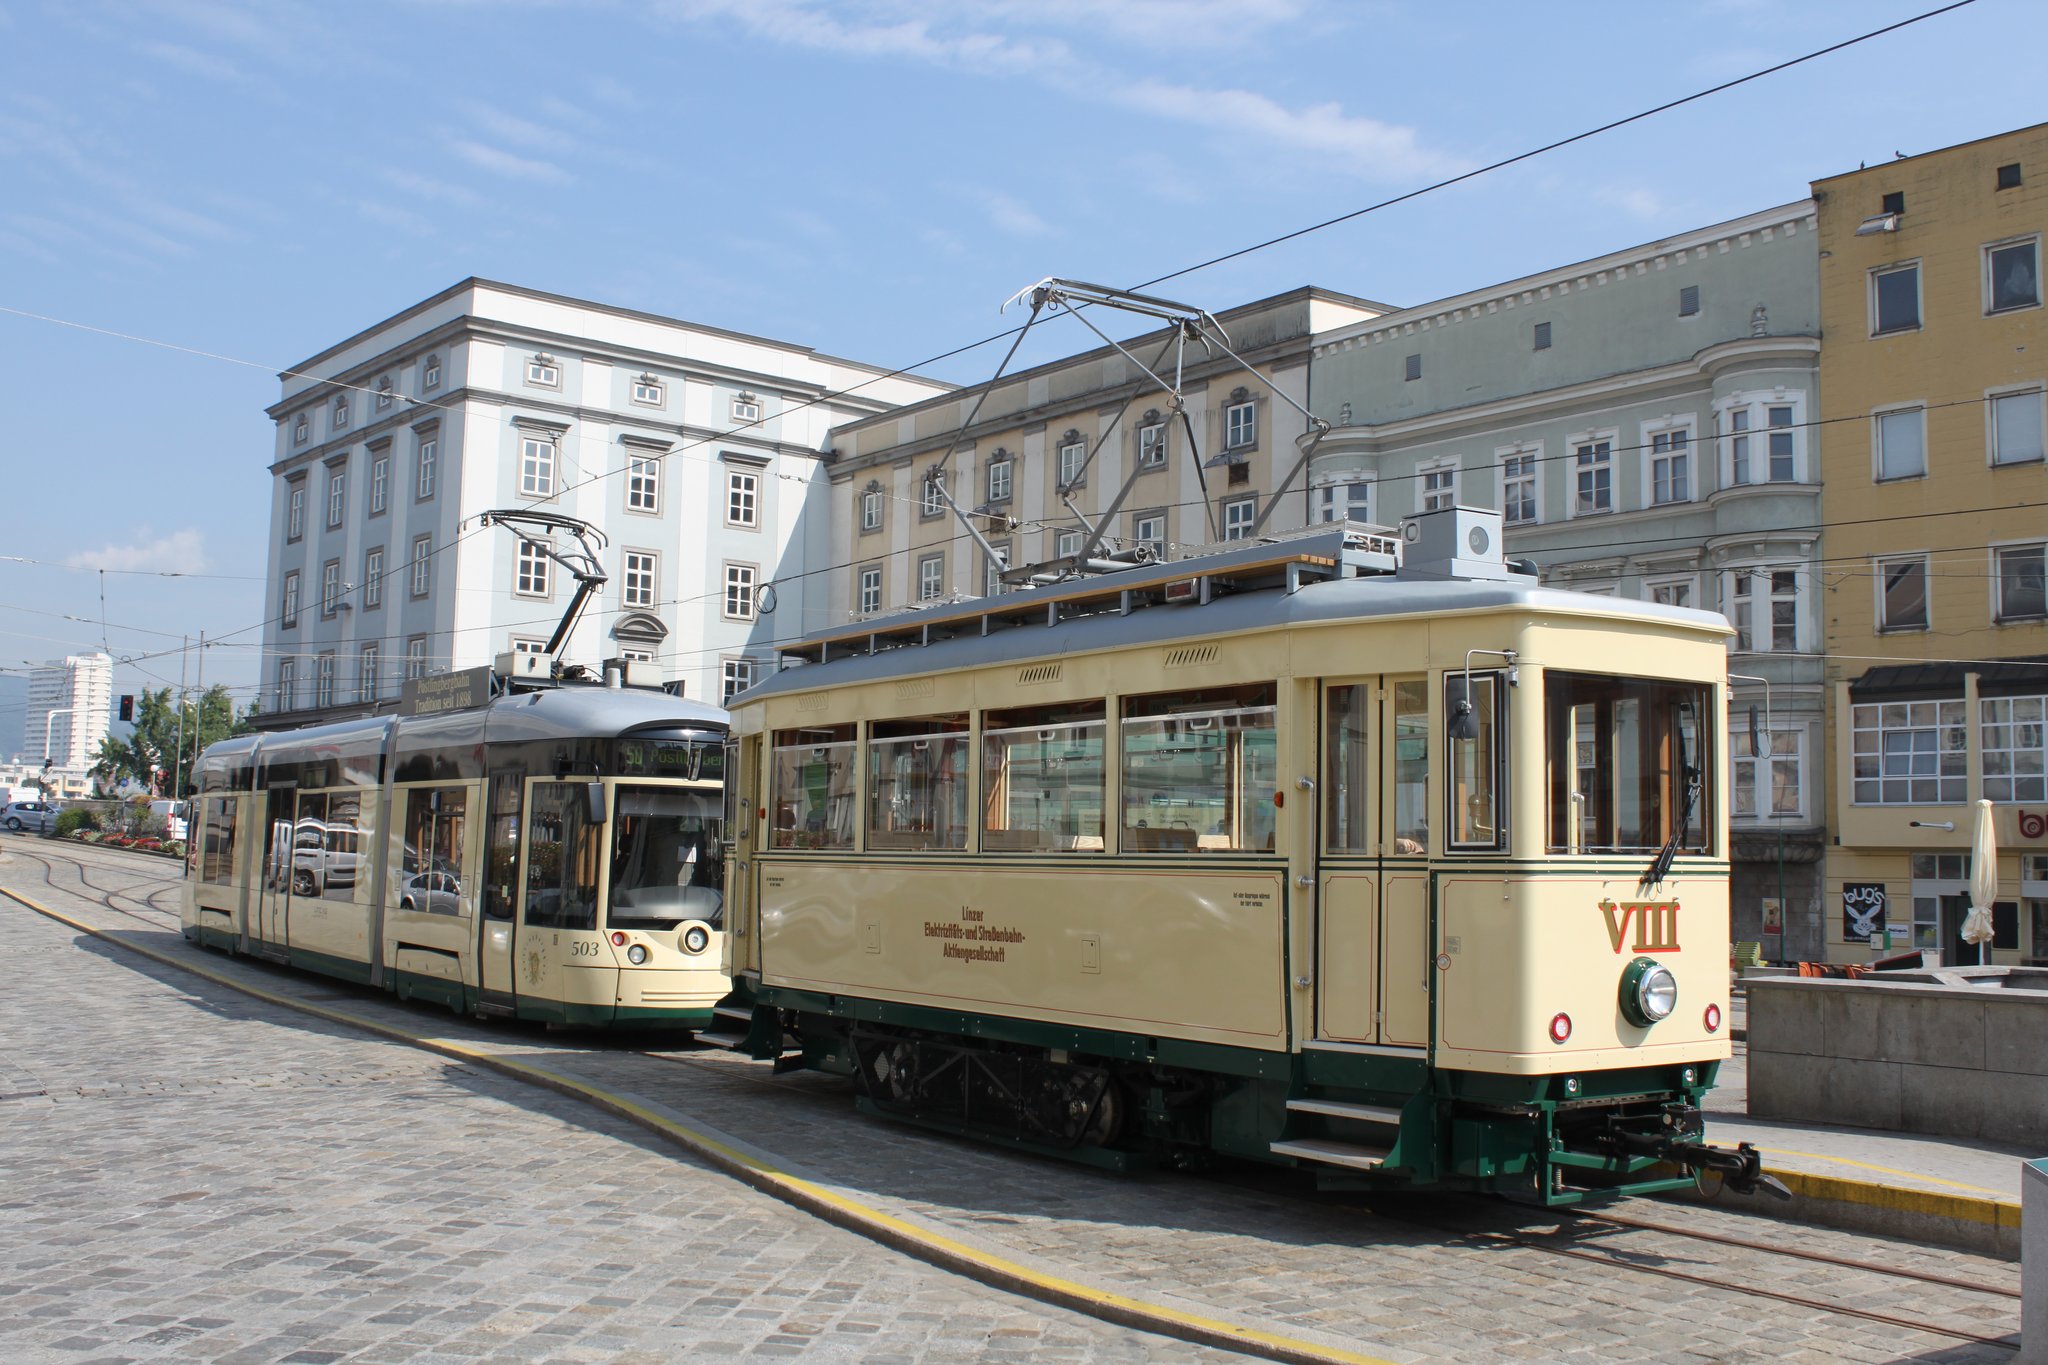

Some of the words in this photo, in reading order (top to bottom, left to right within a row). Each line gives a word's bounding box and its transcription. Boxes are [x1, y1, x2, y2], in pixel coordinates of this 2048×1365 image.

[417, 672, 470, 694] Pöstlingbergbahn
[415, 696, 442, 714] Tradition
[443, 693, 455, 710] seit
[456, 690, 472, 707] 1898
[625, 745, 643, 766] 50
[1843, 887, 1886, 905] bug's
[962, 905, 984, 922] Linzer
[965, 925, 978, 941] und
[1598, 902, 1681, 954] VIII
[571, 941, 600, 957] 503
[943, 942, 1005, 964] Aktiengesellschaft
